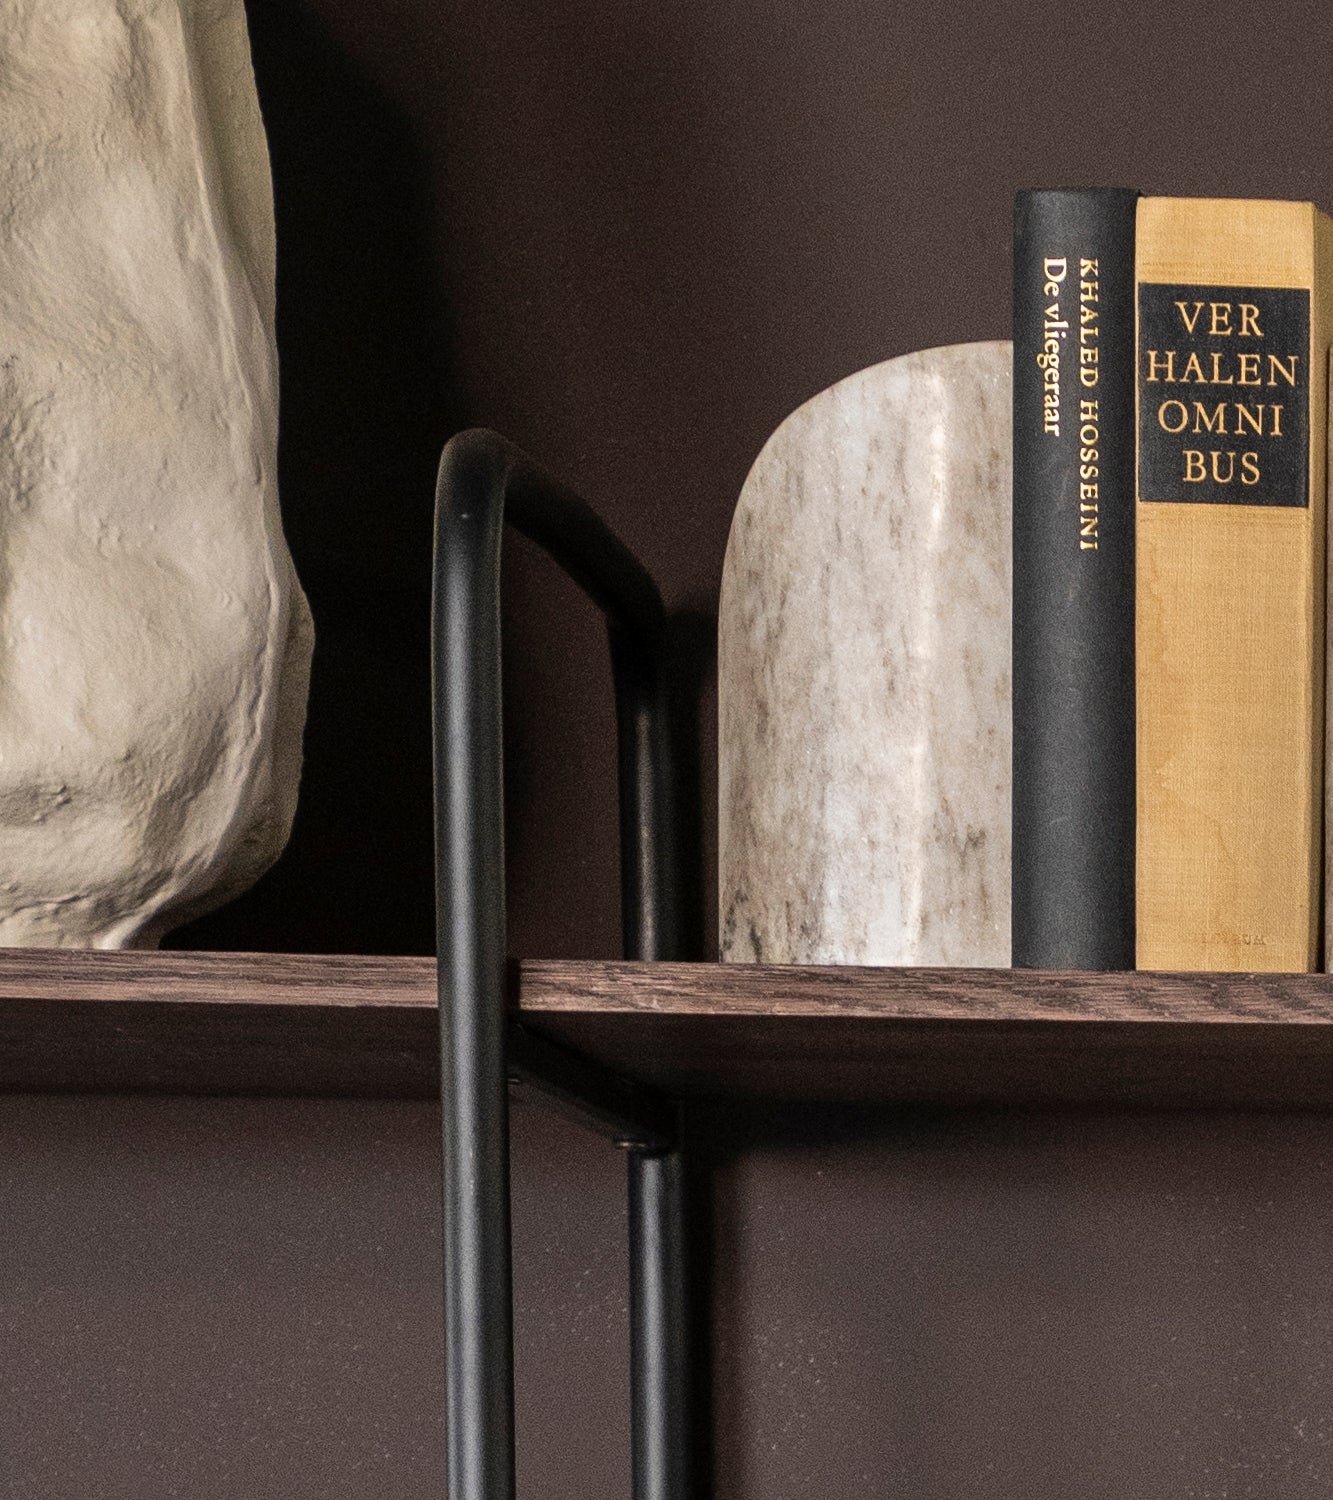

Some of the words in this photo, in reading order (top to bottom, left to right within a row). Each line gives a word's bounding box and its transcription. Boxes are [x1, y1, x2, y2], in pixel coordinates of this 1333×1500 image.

[1043, 257, 1067, 297] De
[1079, 257, 1100, 388] KHALED
[1174, 301, 1265, 337] VER
[1037, 303, 1069, 437] vliegeraar
[1146, 350, 1299, 387] HALEN
[1157, 400, 1284, 436] OMNI
[1079, 400, 1100, 551] HOSSEINI
[1182, 450, 1261, 485] BUS
